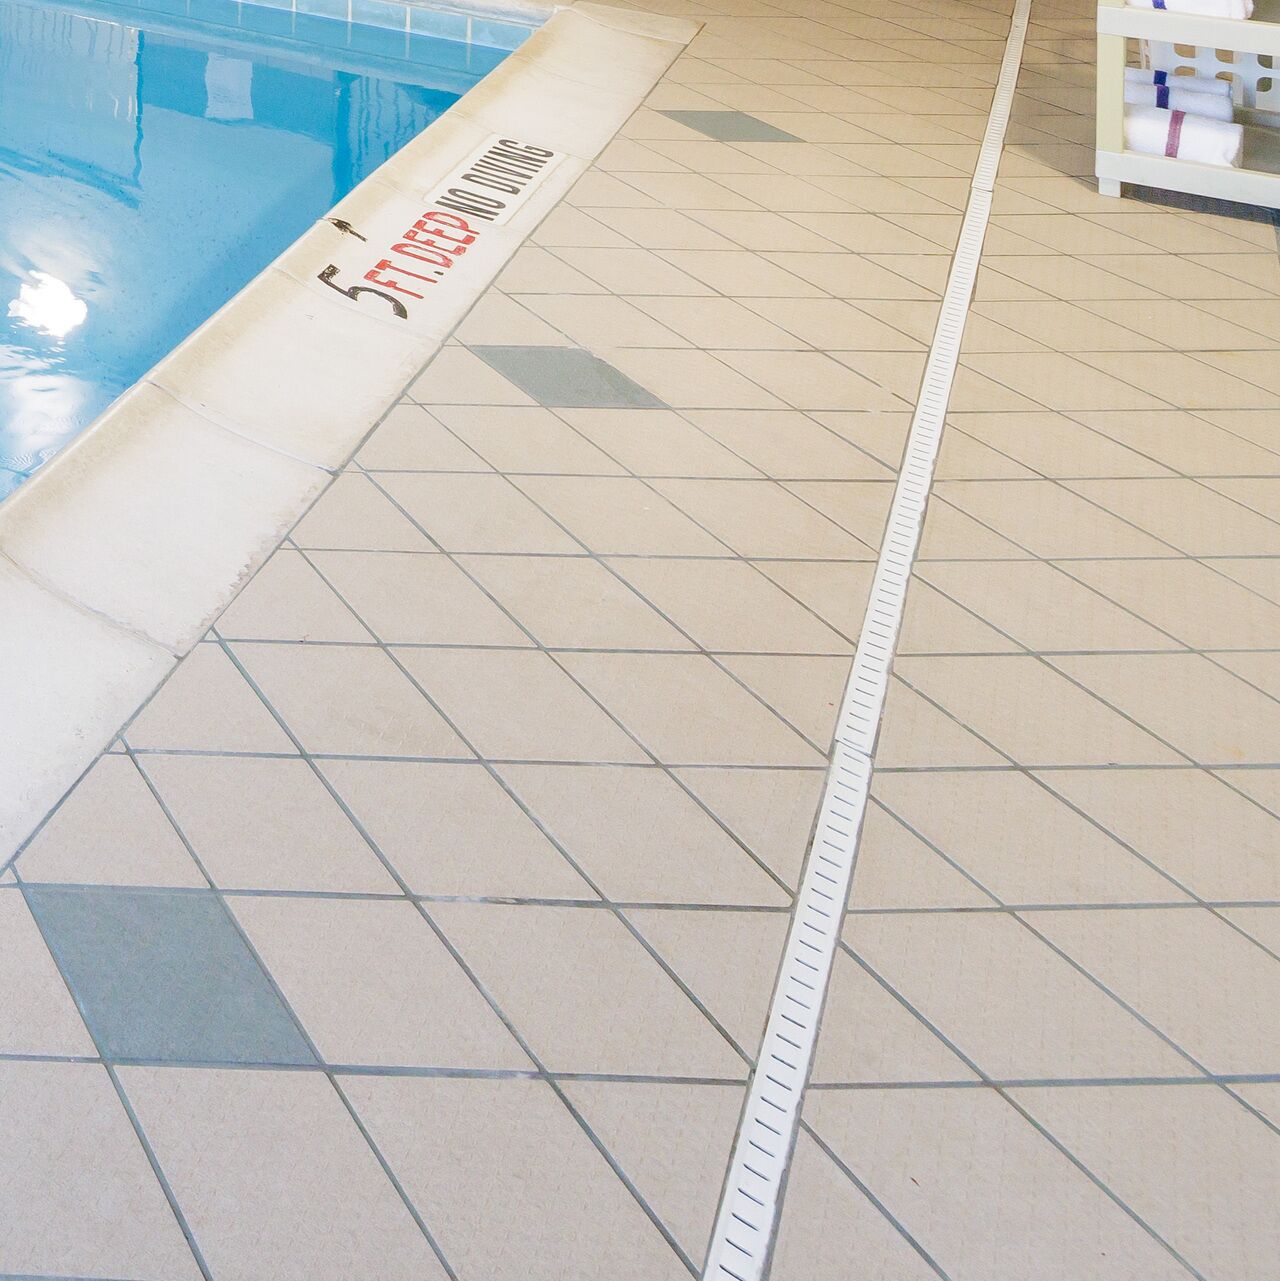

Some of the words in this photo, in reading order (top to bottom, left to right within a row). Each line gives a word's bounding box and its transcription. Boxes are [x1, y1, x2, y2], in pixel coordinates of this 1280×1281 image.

[461, 139, 554, 195] DIVING
[434, 188, 506, 221] NO
[390, 211, 481, 269] DEEP
[317, 263, 408, 320] 5
